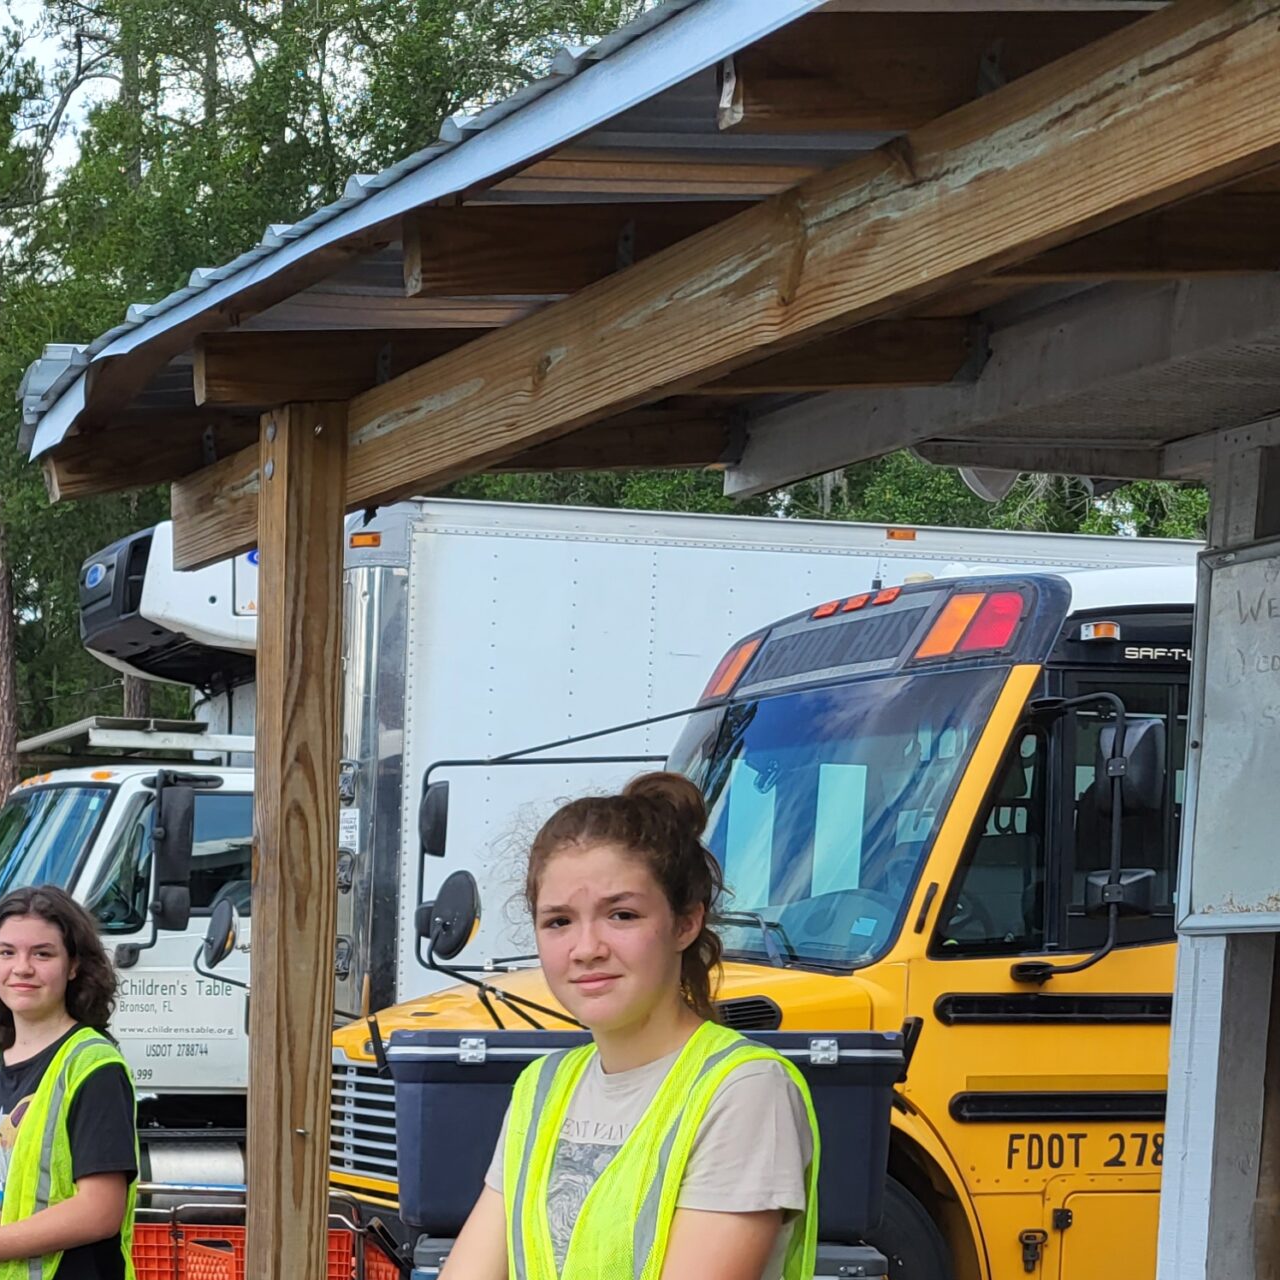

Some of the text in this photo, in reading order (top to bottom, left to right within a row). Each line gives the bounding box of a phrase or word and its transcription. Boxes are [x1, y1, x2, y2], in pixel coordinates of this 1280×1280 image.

[744, 607, 926, 685] SCHOOL BUS
[120, 979, 233, 996] Children's Table
[119, 1000, 174, 1014] Bronson, FL
[119, 1026, 235, 1035] www.childrenstable.org
[146, 1043, 172, 1057] USDOT
[1007, 1133, 1165, 1170] FDOT 278
